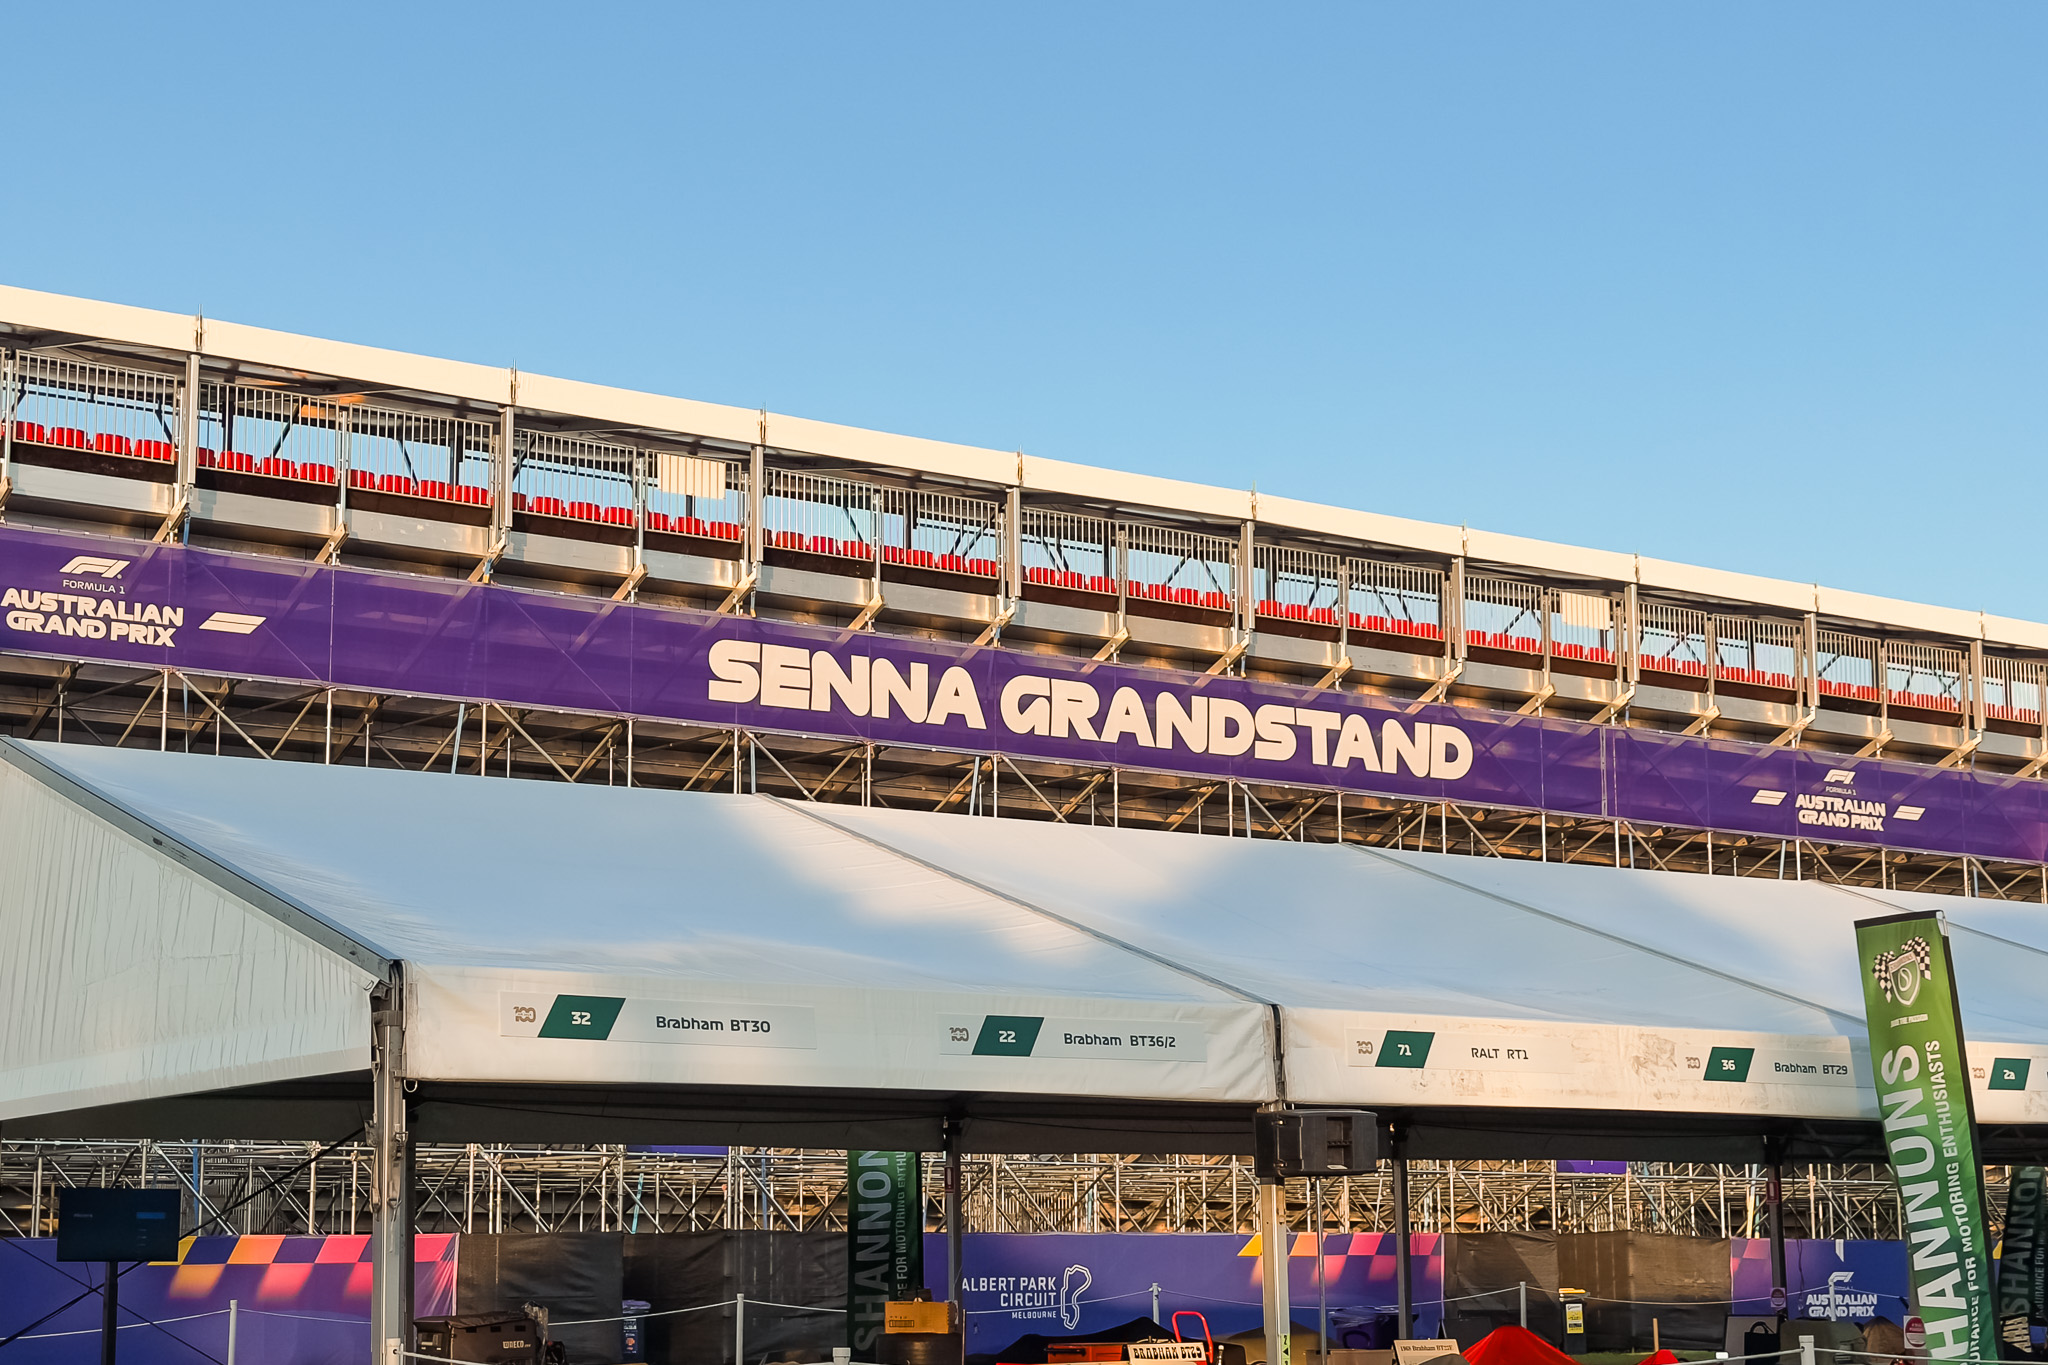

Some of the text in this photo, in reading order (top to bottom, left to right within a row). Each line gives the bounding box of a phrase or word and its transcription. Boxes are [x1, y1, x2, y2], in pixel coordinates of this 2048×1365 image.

[63, 579, 125, 595] FORMULA 1
[1, 588, 184, 627] AUSTRALIAN
[6, 610, 177, 648] GRAND PRIX
[708, 639, 1474, 780] SENNA GRANDSTAND
[1826, 786, 1852, 795] FORMULA
[1795, 794, 1887, 817] AUSTRALIAN
[1798, 809, 1884, 831] GRAND PRIX
[571, 1011, 592, 1026] 32
[656, 1015, 724, 1031] Brabham
[731, 1019, 771, 1033] BT30
[998, 1030, 1016, 1043] 22
[1064, 1033, 1122, 1046] Brabham
[1130, 1035, 1176, 1048] BT36/2
[1397, 1044, 1412, 1056] 71
[1471, 1047, 1500, 1059] RALT
[1507, 1049, 1529, 1060] RT1
[1721, 1059, 1736, 1071] 36
[1774, 1062, 1817, 1074] Brabham
[1823, 1065, 1848, 1075] BT29
[1925, 1040, 1958, 1158] ENTHUSIASTS
[896, 1151, 907, 1188] ENTHU
[1881, 1045, 1969, 1365] HANNONS
[1946, 1162, 1973, 1252] MOTORING
[895, 1195, 906, 1254] MOTORING
[854, 1151, 891, 1351] SHANNON
[896, 1256, 908, 1280] FOR
[1965, 1257, 1979, 1291] FOR
[962, 1277, 1056, 1291] ALBERT PARK
[1000, 1292, 1056, 1307] CIRCUIT
[1012, 1311, 1057, 1319] MELBOURNE
[1849, 1306, 1875, 1317] PRIX
